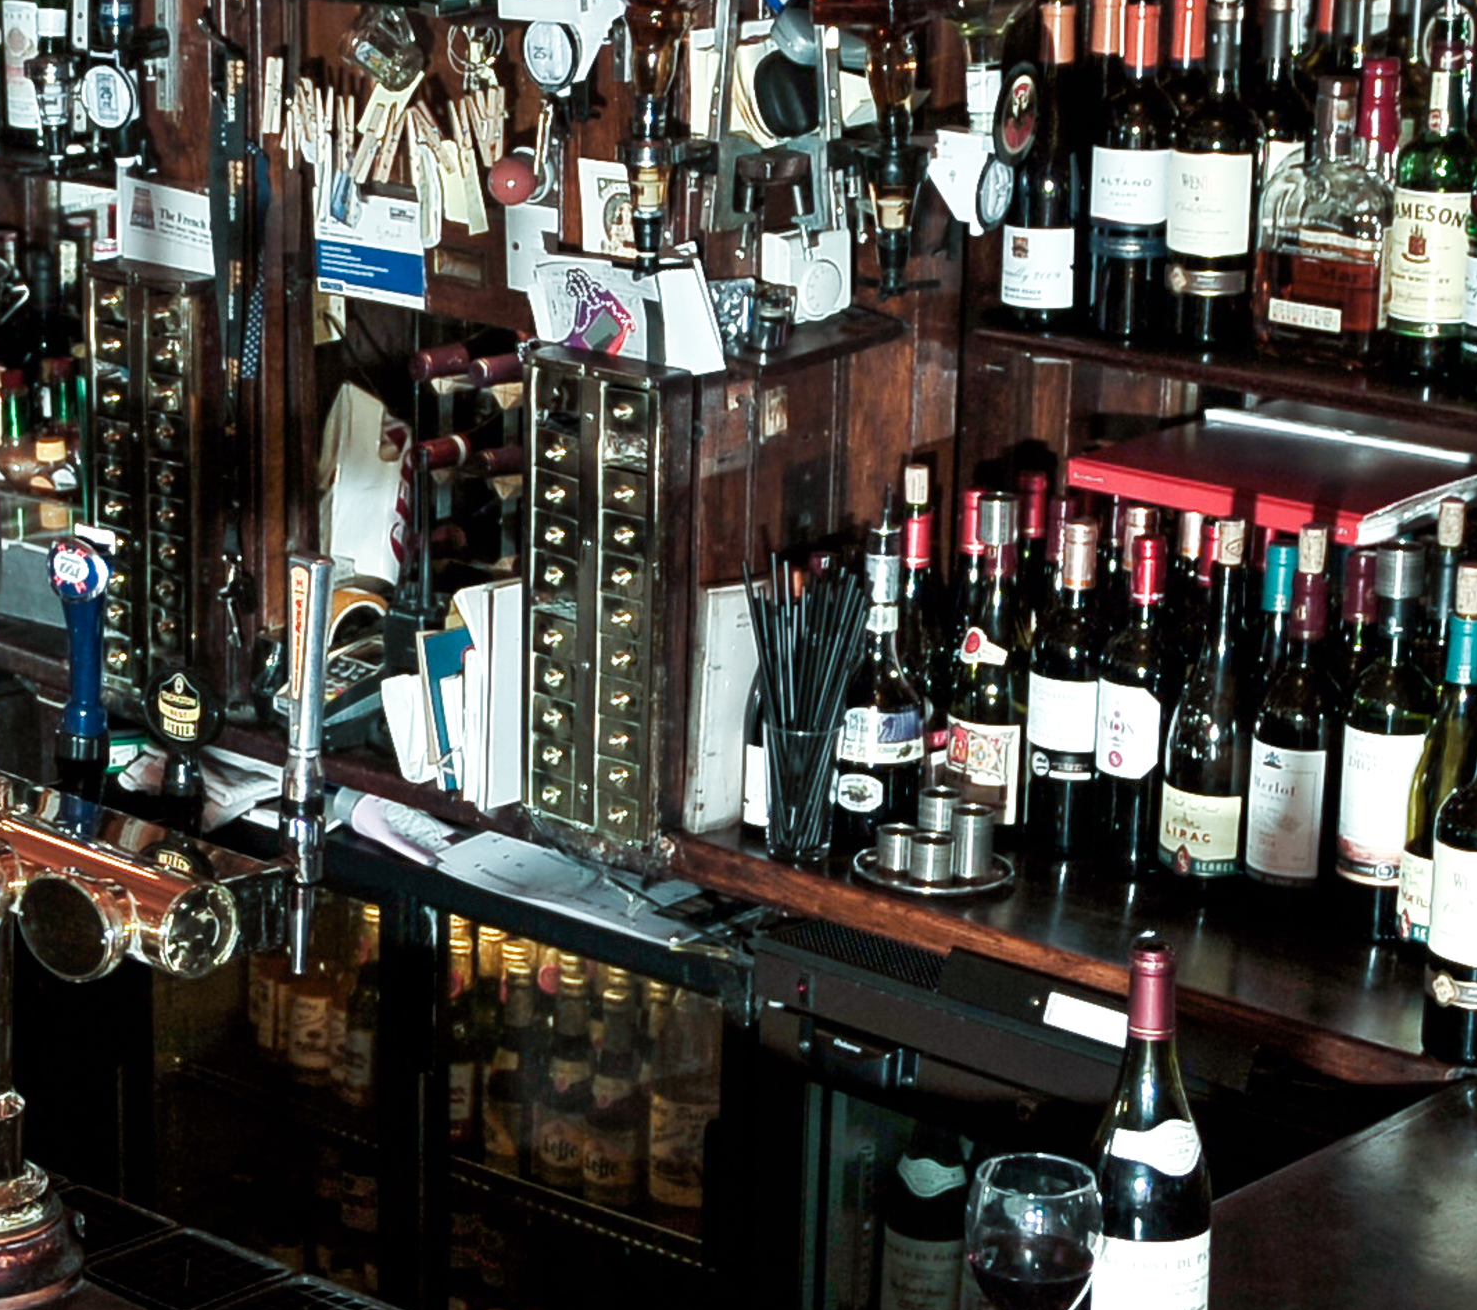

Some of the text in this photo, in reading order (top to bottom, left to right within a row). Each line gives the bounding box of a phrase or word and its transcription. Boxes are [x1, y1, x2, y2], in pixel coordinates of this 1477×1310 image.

[160, 206, 207, 231] The French
[1165, 820, 1211, 844] LIRAC
